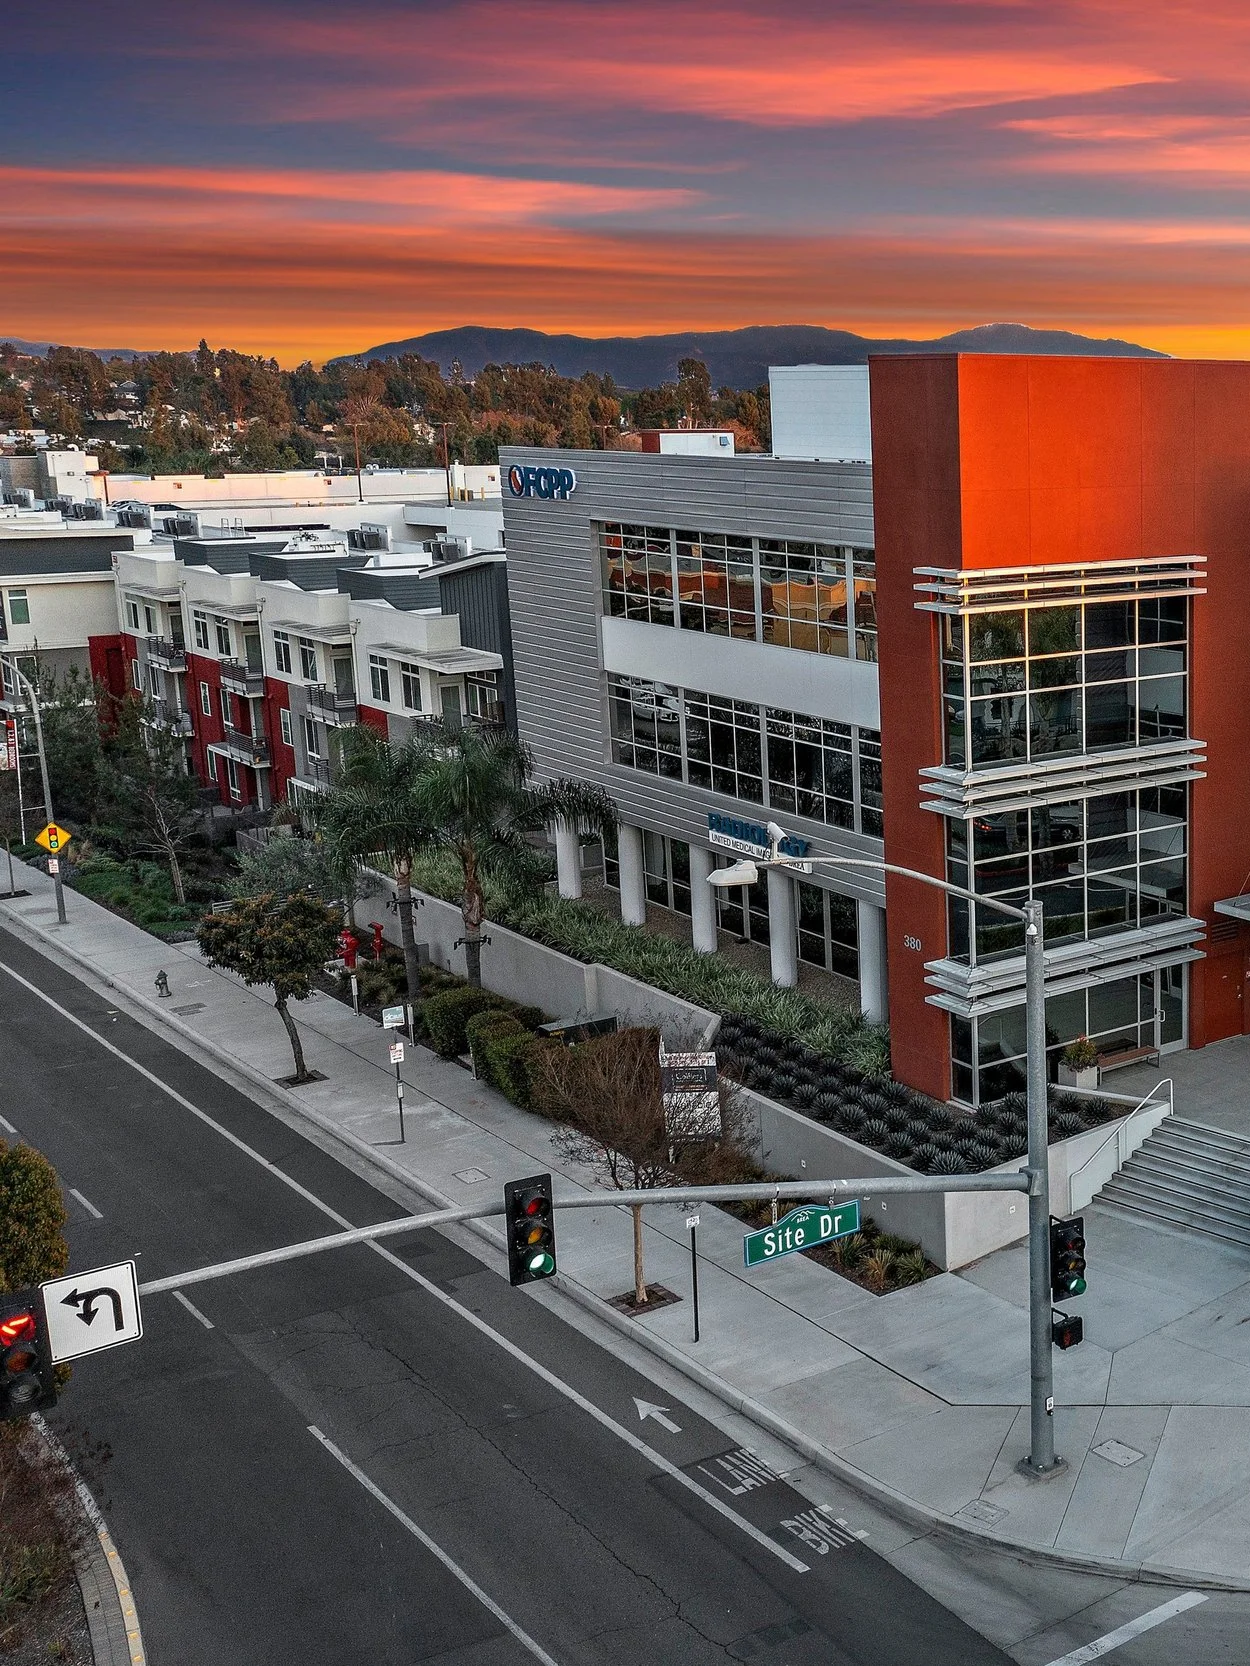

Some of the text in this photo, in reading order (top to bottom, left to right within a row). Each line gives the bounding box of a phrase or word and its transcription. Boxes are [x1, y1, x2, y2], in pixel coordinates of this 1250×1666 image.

[523, 466, 576, 500] FCPP
[711, 833, 731, 847] UNITED
[731, 839, 756, 855] MEDICAL
[903, 934, 922, 952] 380
[763, 1214, 842, 1256] Site Dr
[697, 1446, 791, 1496] LANE
[780, 1503, 870, 1555] BIKE
